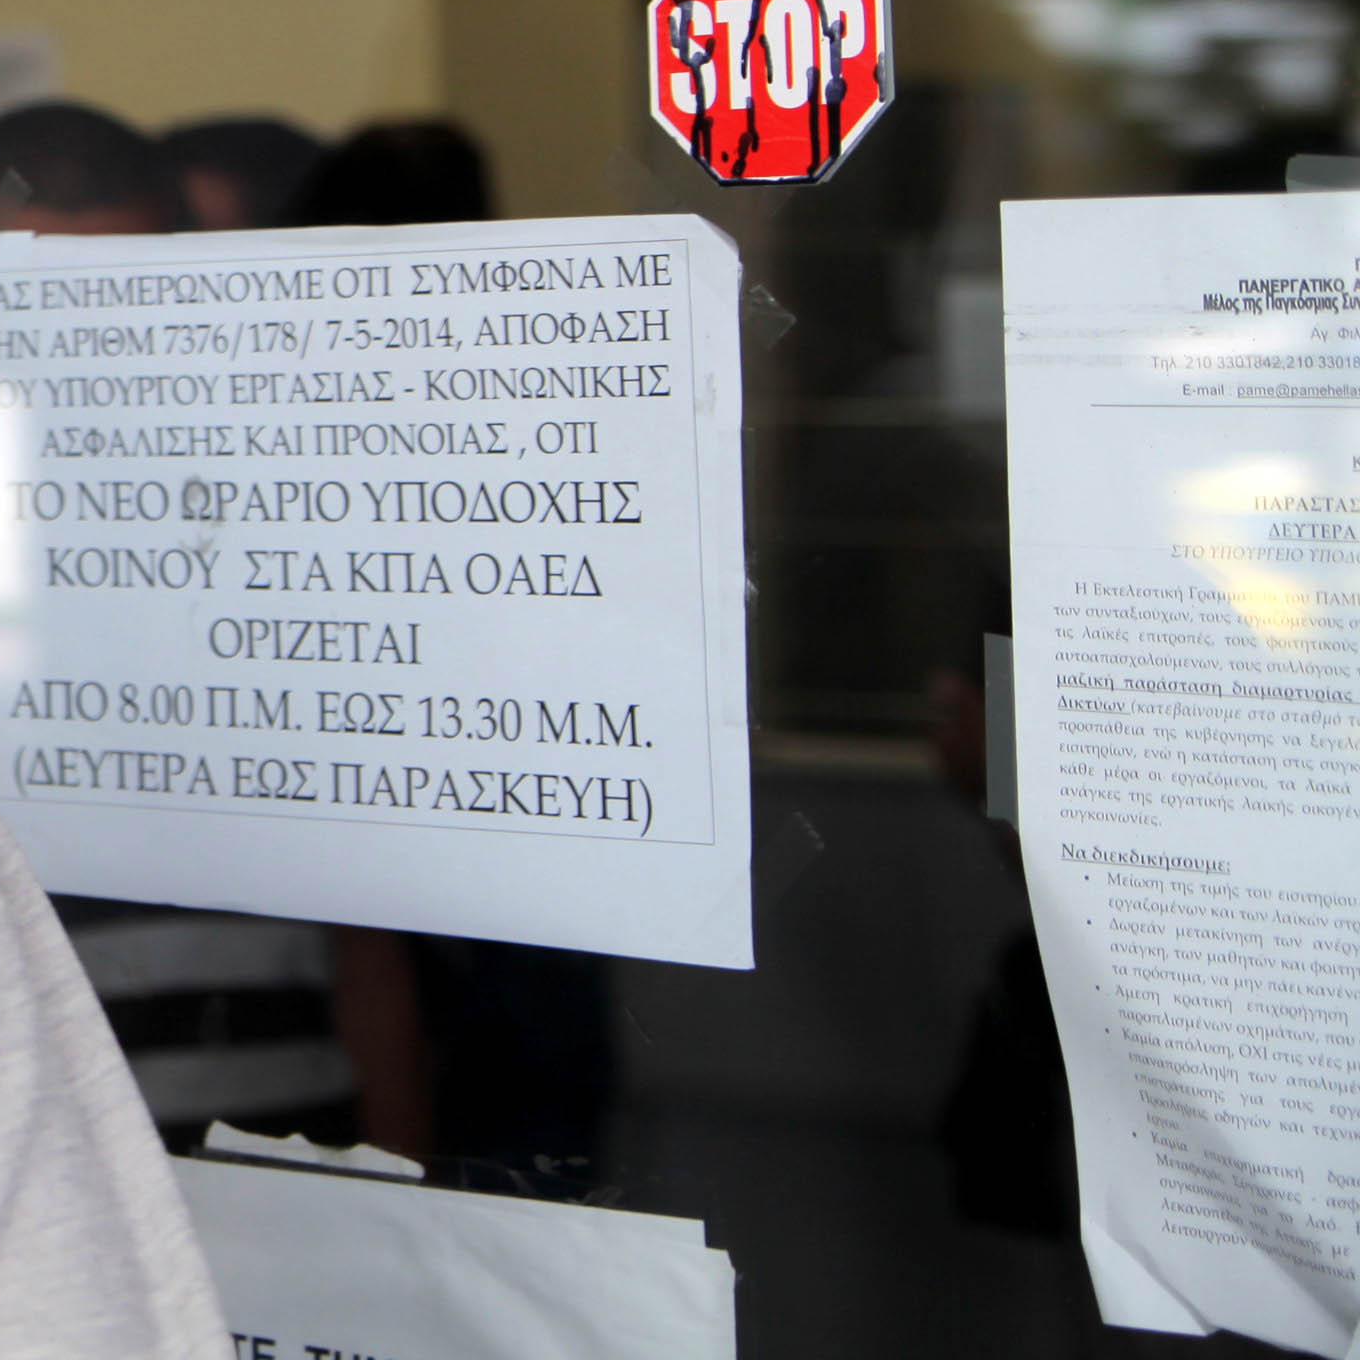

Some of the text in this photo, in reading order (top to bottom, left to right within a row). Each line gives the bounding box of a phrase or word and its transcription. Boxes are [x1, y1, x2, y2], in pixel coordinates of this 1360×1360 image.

[40, 269, 325, 311] ΕΝΗΜΕΡΩΝΟΥΜΕ
[331, 265, 392, 299] ΟΤΙ
[410, 258, 606, 296] ΣΥΜΦΩΝΑ
[614, 254, 672, 288] ΜΕ
[49, 325, 156, 359] ΑΡΙΘΜ
[326, 317, 463, 353] 7-5-2014,
[475, 310, 673, 347] ΑΠΟΦΑΣΗ
[44, 375, 218, 408] ΥΠΟΥΡΓΟΥ
[229, 370, 396, 405] ΕΡΓΑΣΙΑΣ
[423, 364, 673, 403] ΚΟΙΝΩΝΙΚΗΣ
[40, 420, 600, 458] ΑΣΦΑΛΙΣΗΣ ΚΑΙ ΠΡΟΝΟΙΑΣ ΟΤΙ
[8, 478, 642, 524] ΤΟ ΝΕΟ ΩΡΑΡΙΟ ΥΠΟΔΟΧΗΣ
[43, 545, 603, 599] ΚΟΙΝΟΥ ΣΤΑ ΚΠΑ ΟΑΕΔ
[208, 617, 422, 666] ΟΡΙΖΕΤΑΙ
[10, 679, 654, 749] ΑΠΟ 8.00 Π.Μ. ΕΩΣ 13.30 Μ.Μ.
[13, 745, 654, 839] (ΔΕΥΤΕΡΑ ΕΩΣ ΠΑΡΑΣΚΕΥΗ)
